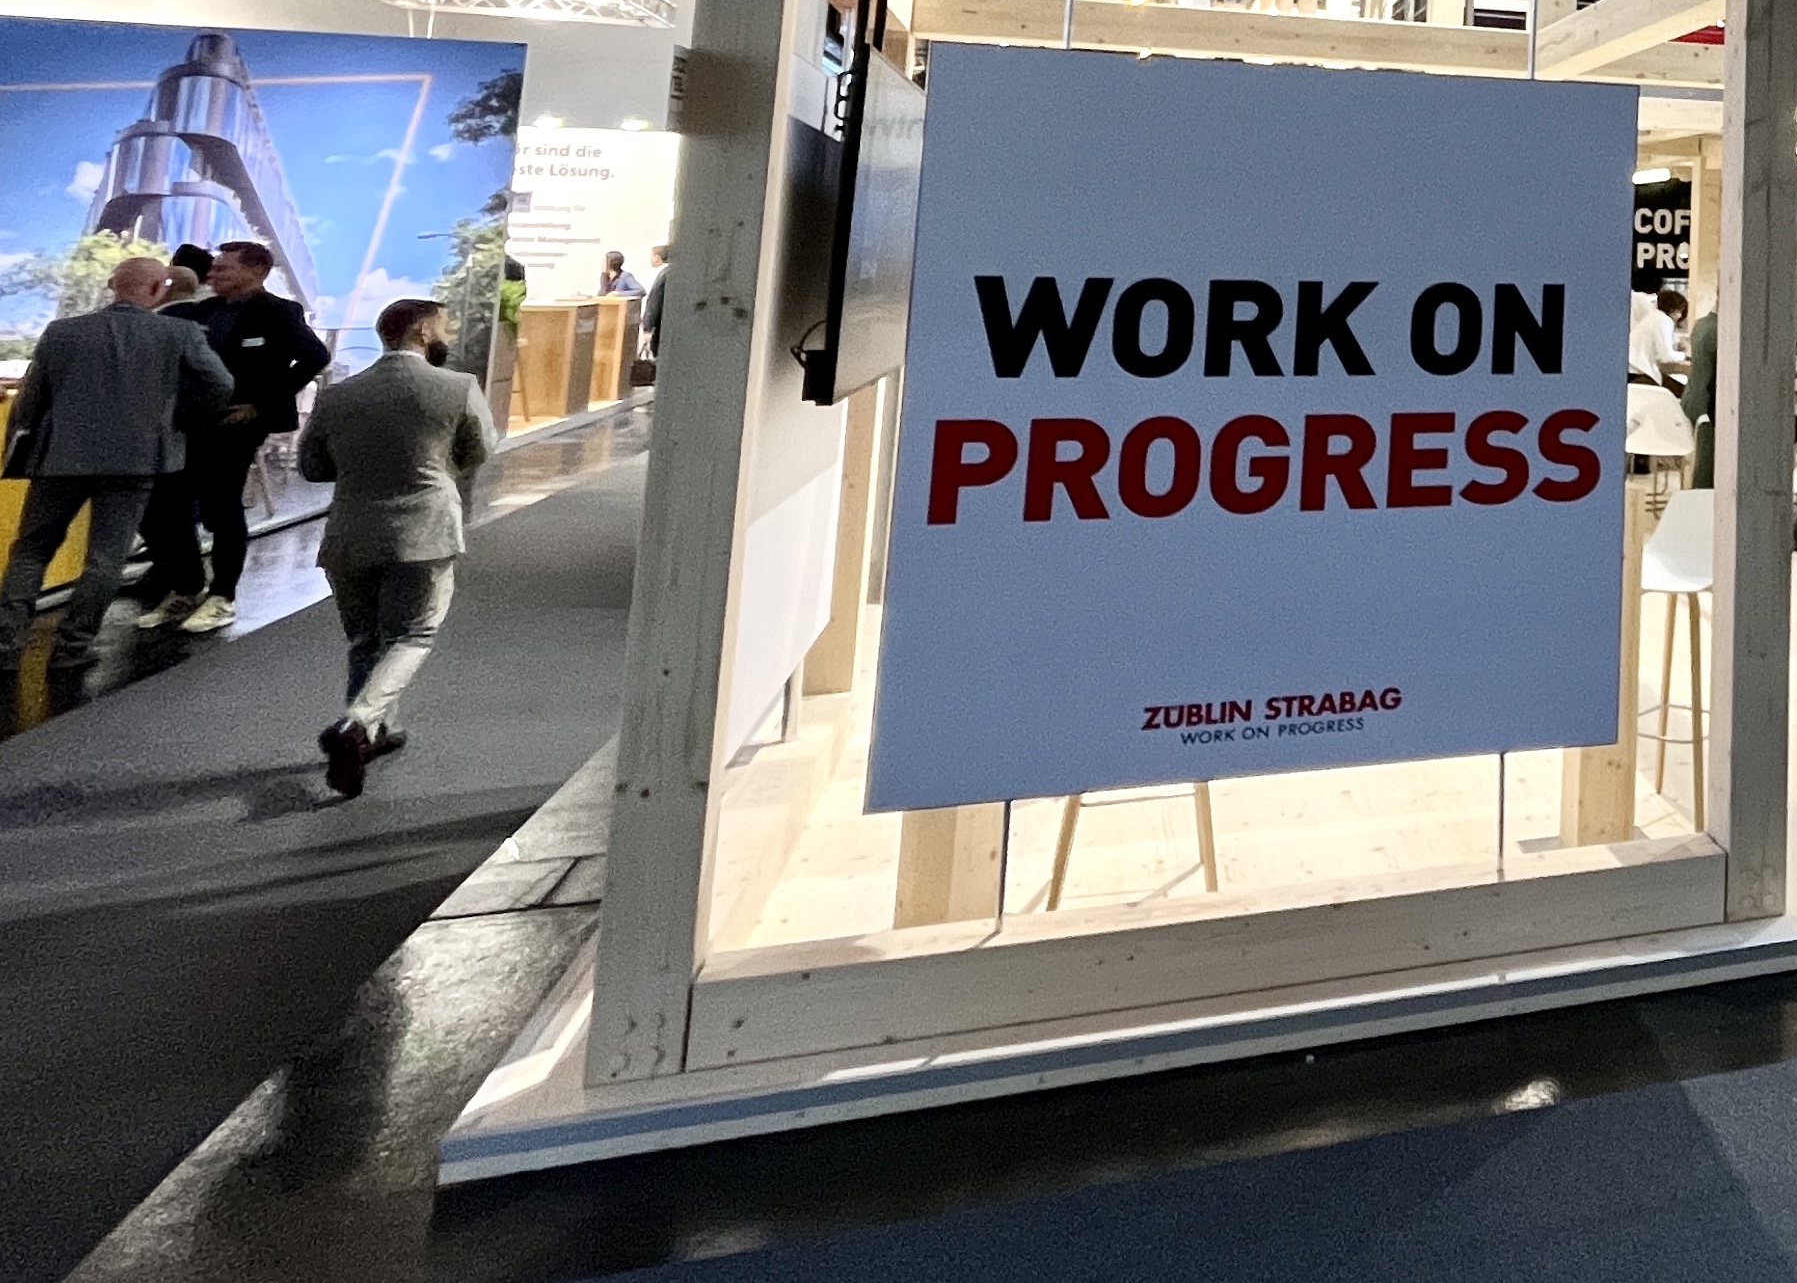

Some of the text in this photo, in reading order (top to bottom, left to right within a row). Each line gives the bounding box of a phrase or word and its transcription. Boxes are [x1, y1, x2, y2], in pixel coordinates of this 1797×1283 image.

[535, 144, 571, 157] sind
[575, 145, 602, 158] die
[549, 163, 615, 180] Lösung.
[974, 275, 1565, 379] WORK ON
[927, 408, 1601, 525] PROGRESS
[1264, 687, 1402, 720] STRABAG
[1180, 717, 1365, 746] WORK ON PROGRESS
